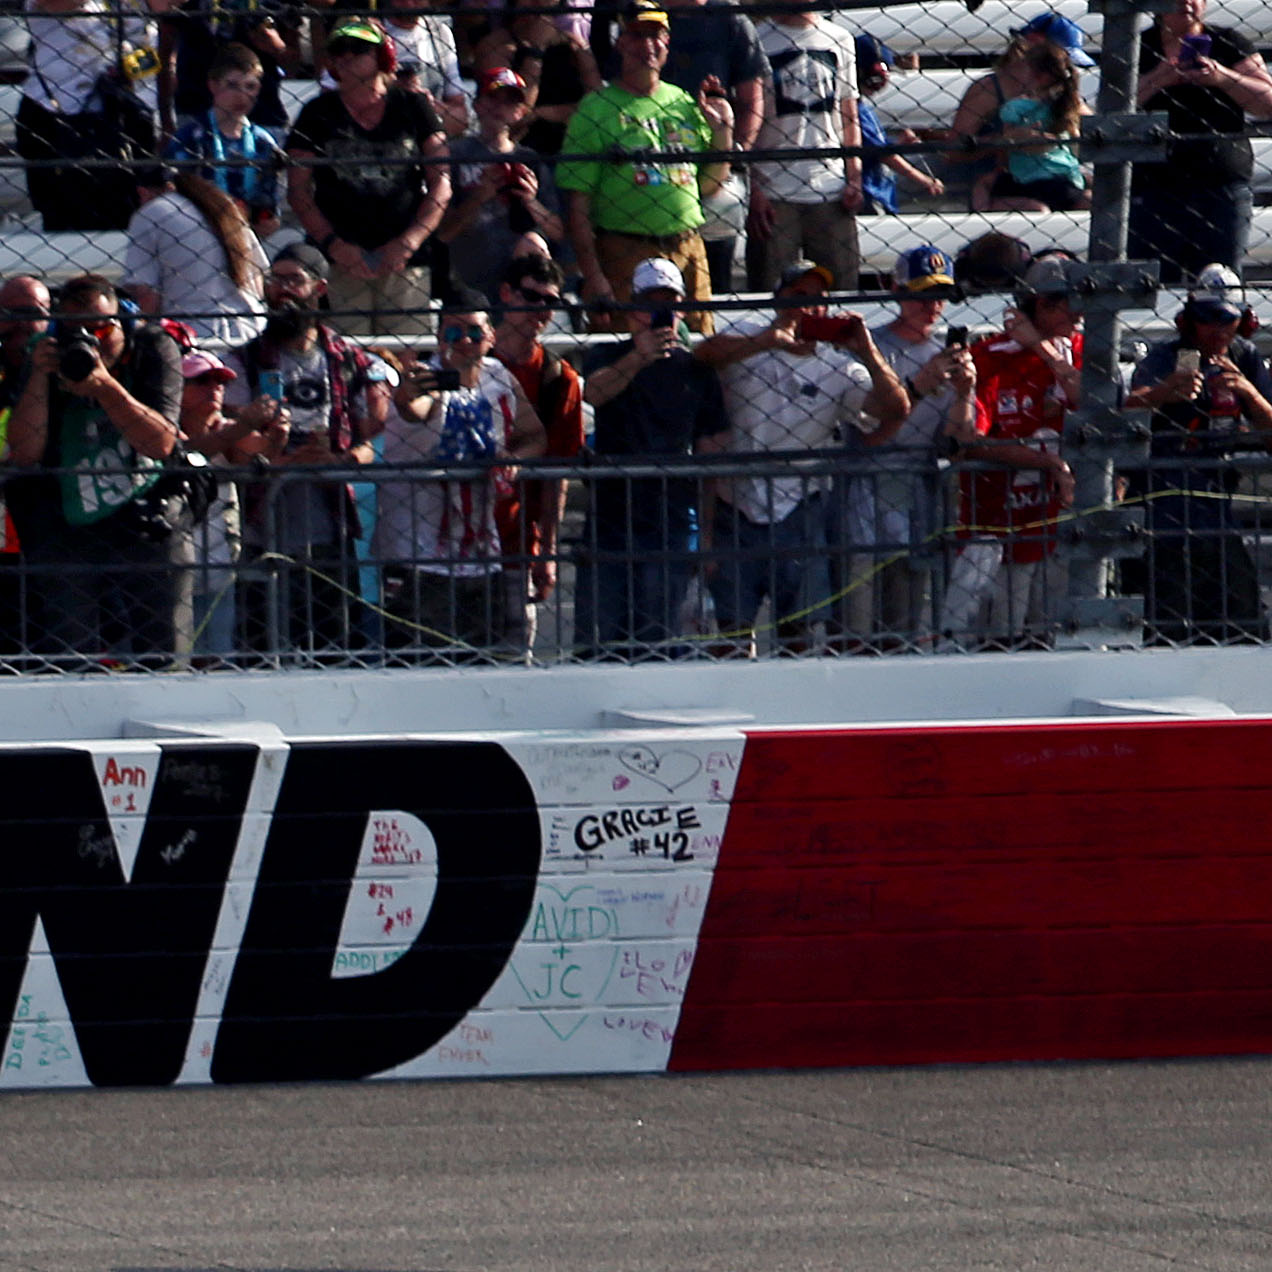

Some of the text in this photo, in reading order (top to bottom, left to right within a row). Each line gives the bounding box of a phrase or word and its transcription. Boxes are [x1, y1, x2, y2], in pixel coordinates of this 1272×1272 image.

[102, 757, 148, 788] Ann
[573, 805, 702, 852] GRACIE
[629, 831, 695, 862] #42
[533, 963, 583, 1000] JC
